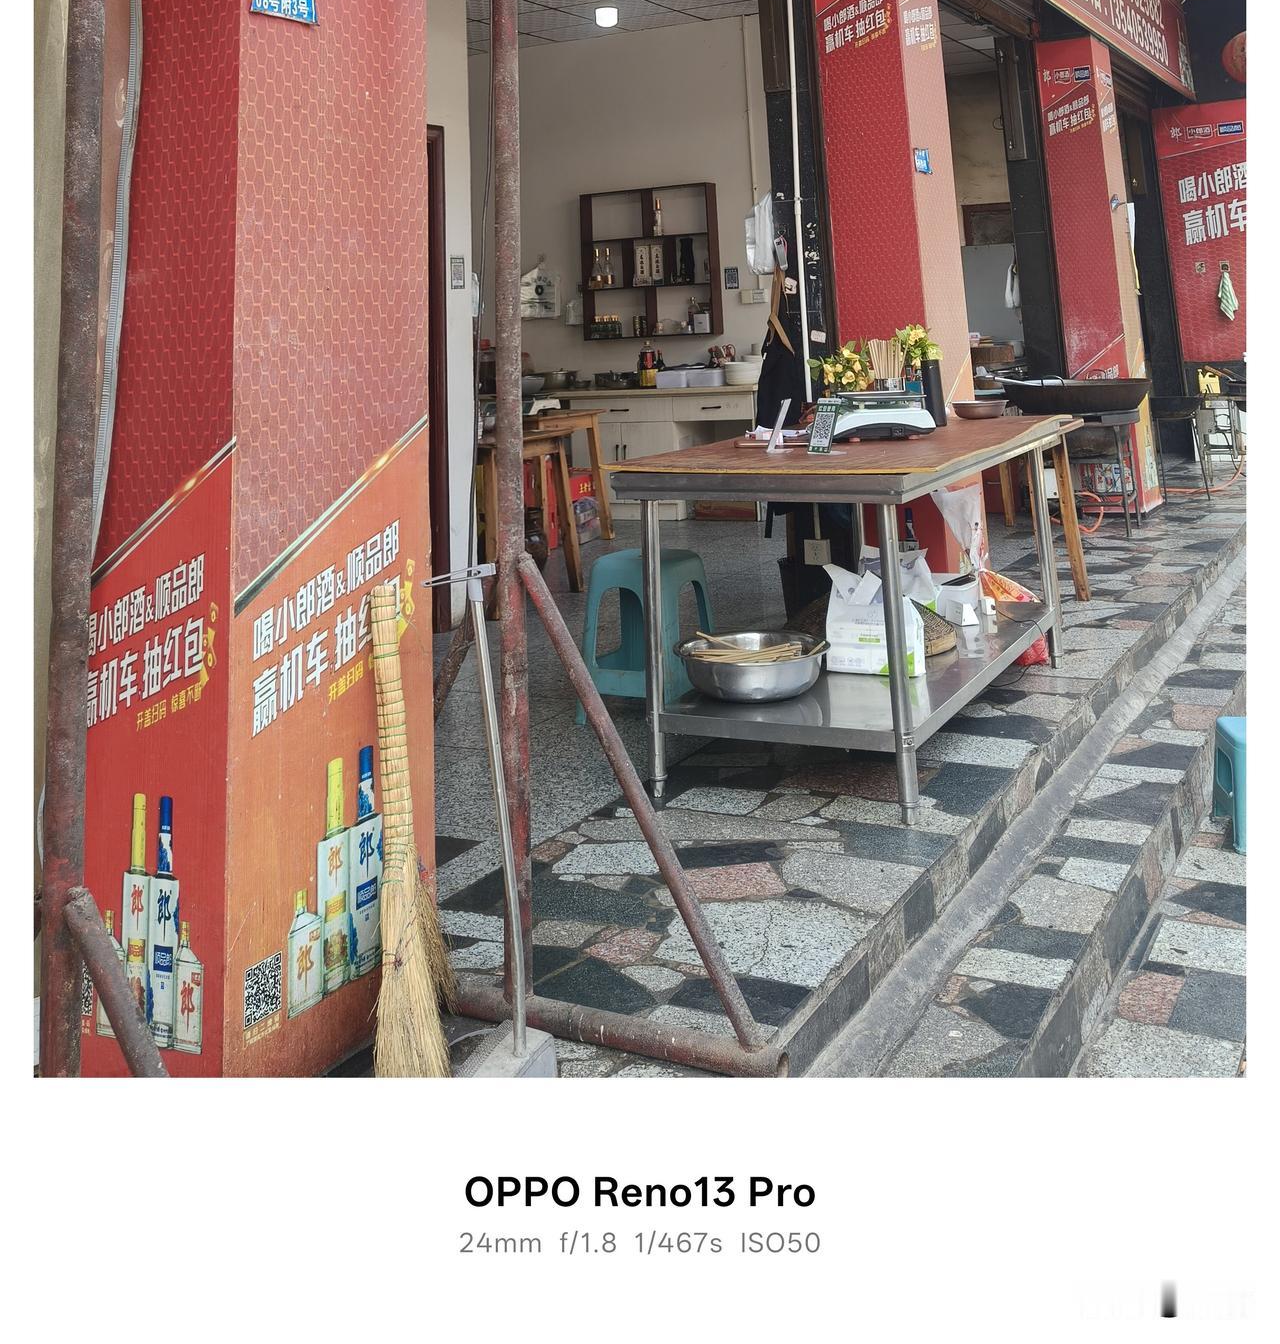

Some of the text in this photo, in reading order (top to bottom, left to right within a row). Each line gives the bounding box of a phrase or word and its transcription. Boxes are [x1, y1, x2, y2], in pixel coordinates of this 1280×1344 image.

[1182, 198, 1246, 246] 赢机车
[253, 518, 400, 663] 喝小郎酒&顺品郎
